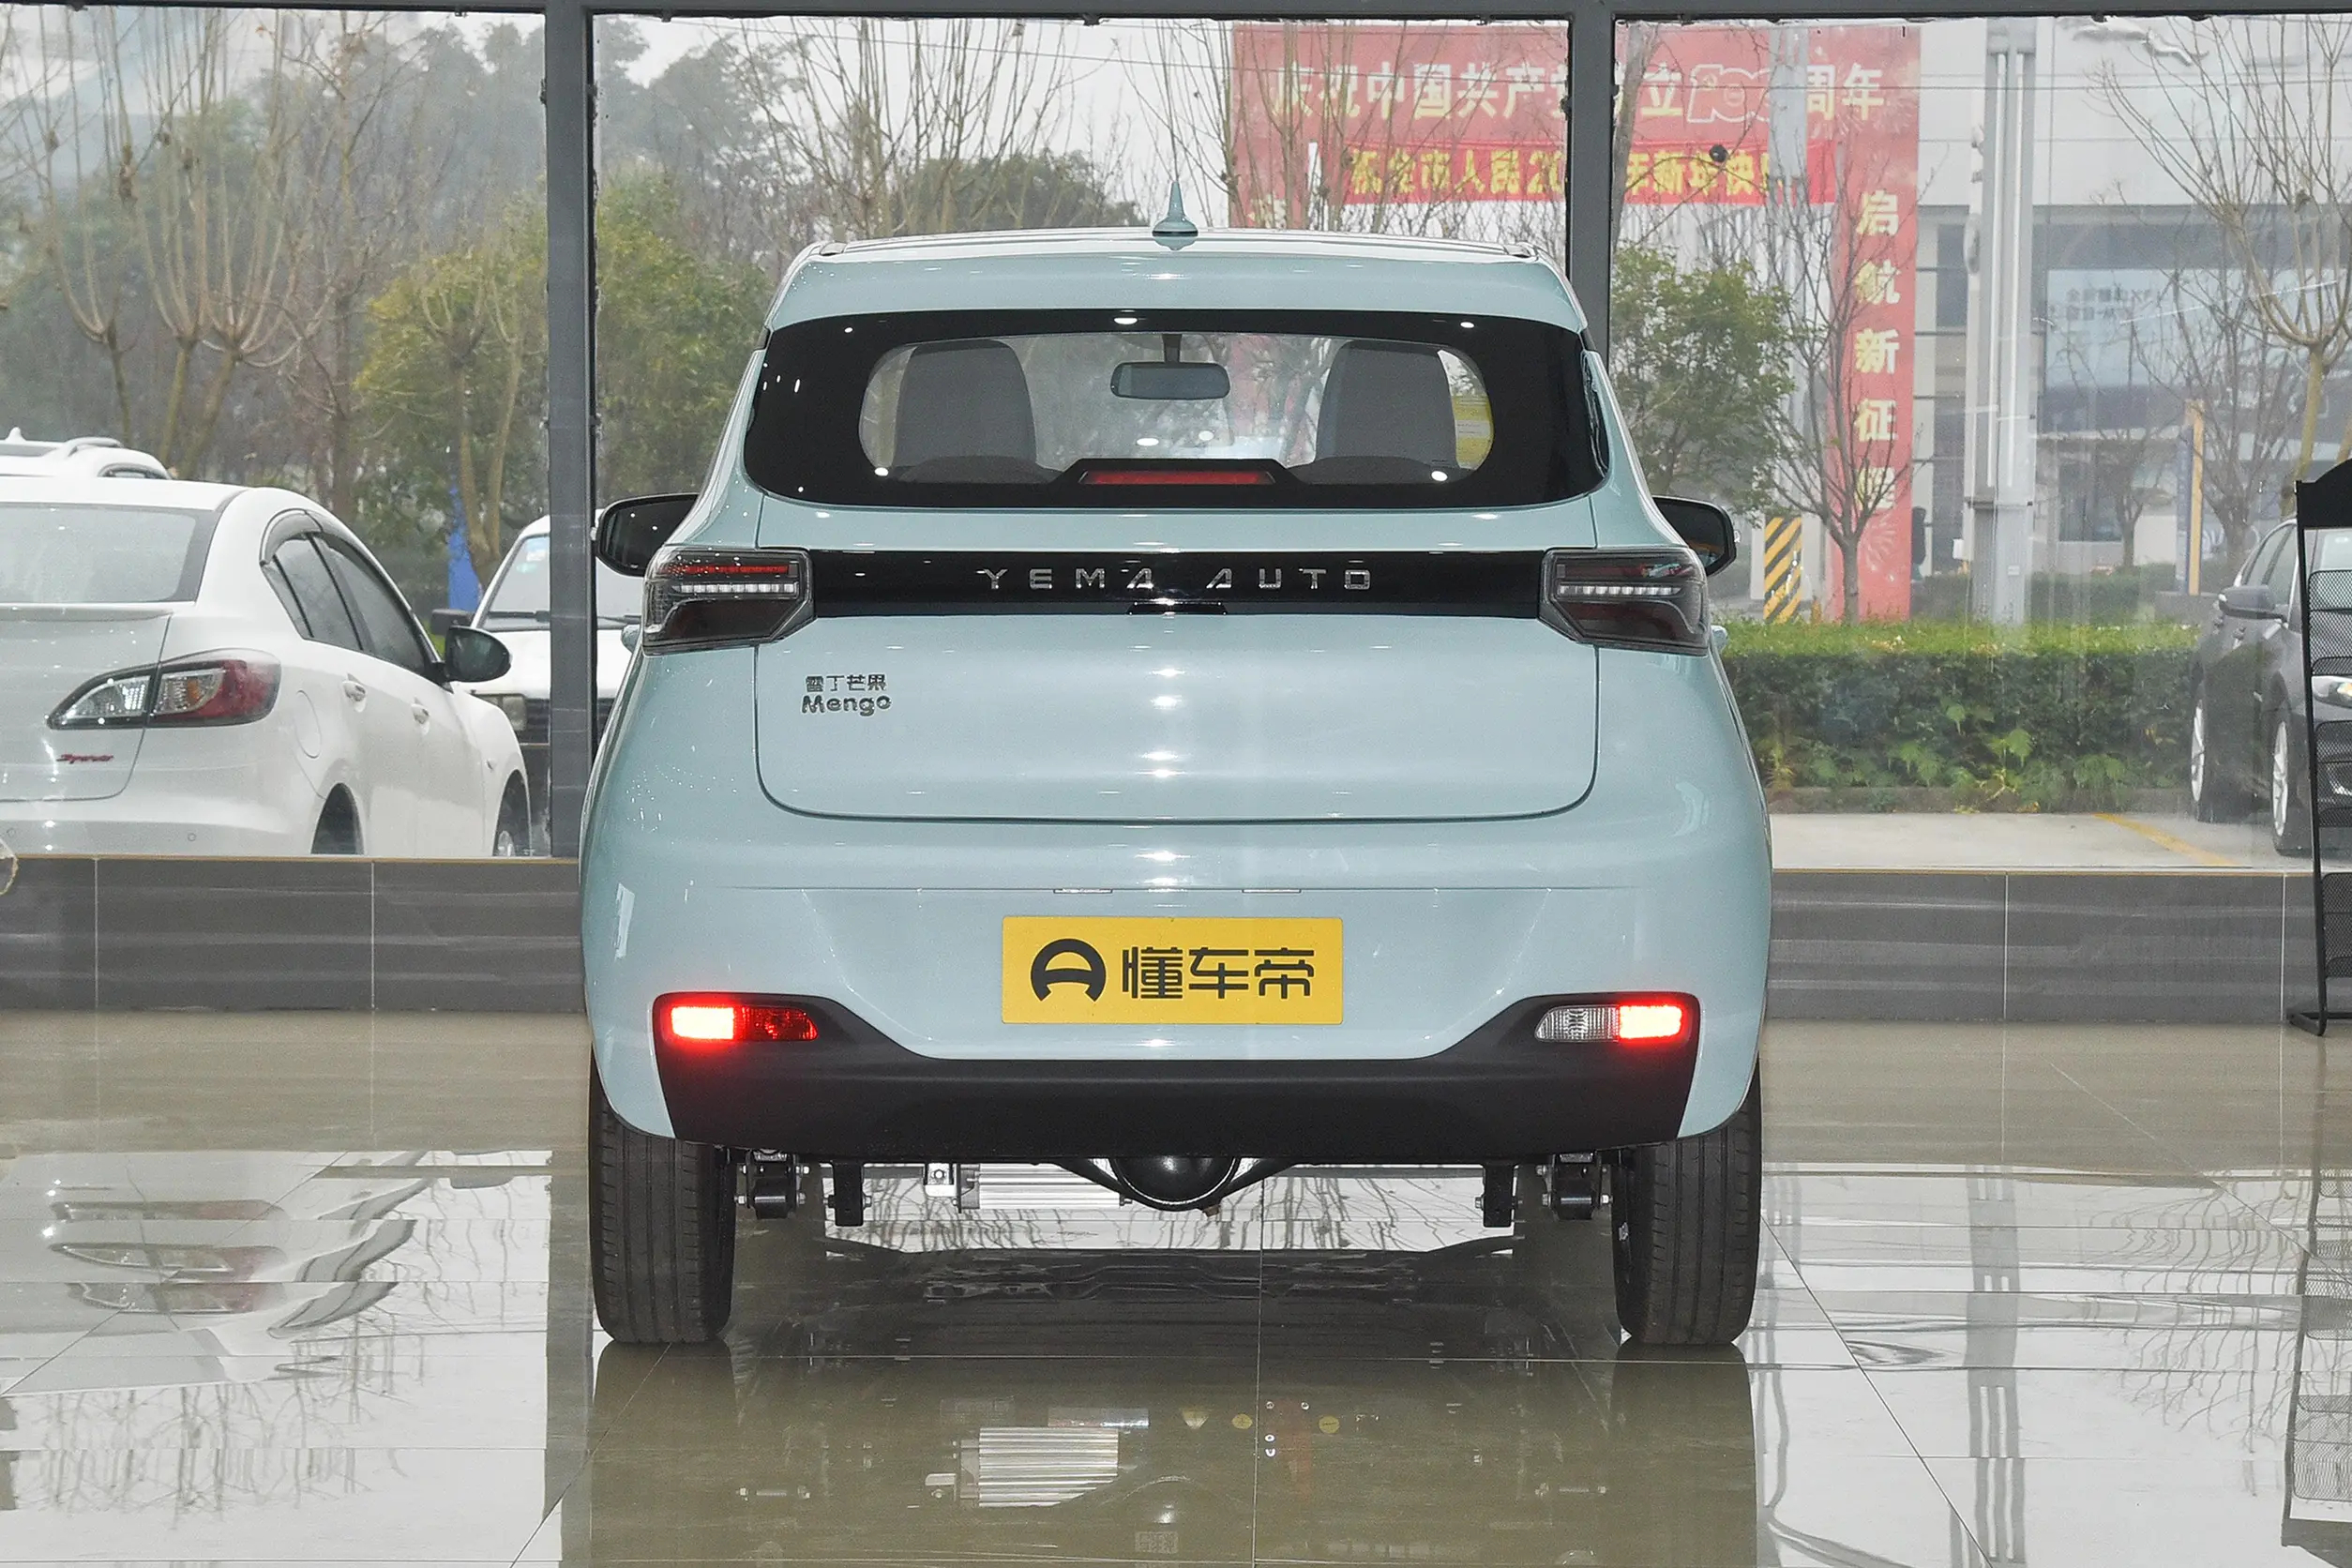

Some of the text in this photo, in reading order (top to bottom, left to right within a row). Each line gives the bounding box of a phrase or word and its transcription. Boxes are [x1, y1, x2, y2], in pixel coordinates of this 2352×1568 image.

[978, 567, 1371, 591] YEMA AUTO
[806, 674, 887, 693] 雷丁芒果
[802, 694, 892, 716] Mengo
[1122, 945, 1315, 1000] 懂车帝
